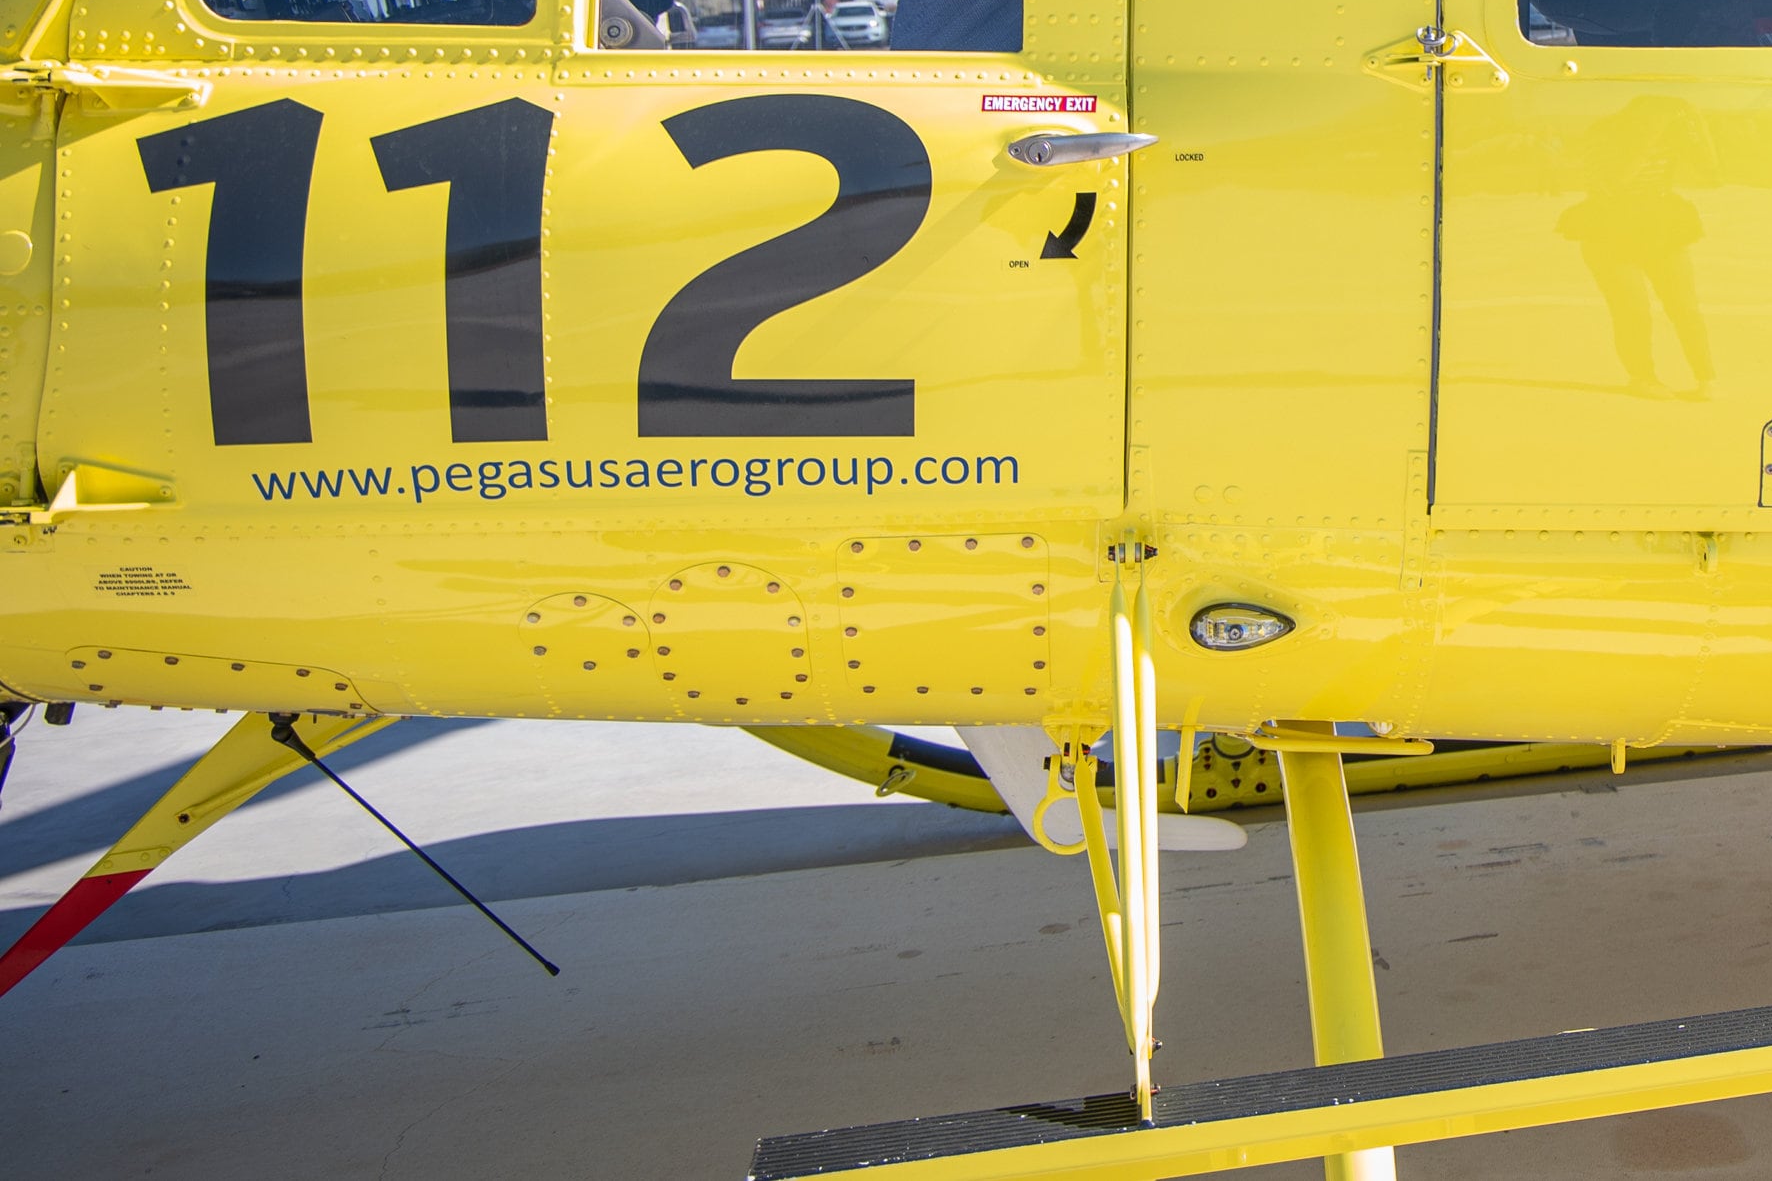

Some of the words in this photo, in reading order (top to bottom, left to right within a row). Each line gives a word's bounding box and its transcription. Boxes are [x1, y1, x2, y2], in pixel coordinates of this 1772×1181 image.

[984, 97, 1062, 111] EMERGENCY
[1065, 97, 1095, 112] EXIT
[1175, 153, 1204, 162] LOCKED
[136, 93, 932, 446] 112
[1009, 260, 1029, 268] OPEN
[251, 452, 1018, 501] www.pegasusaerogroup.com
